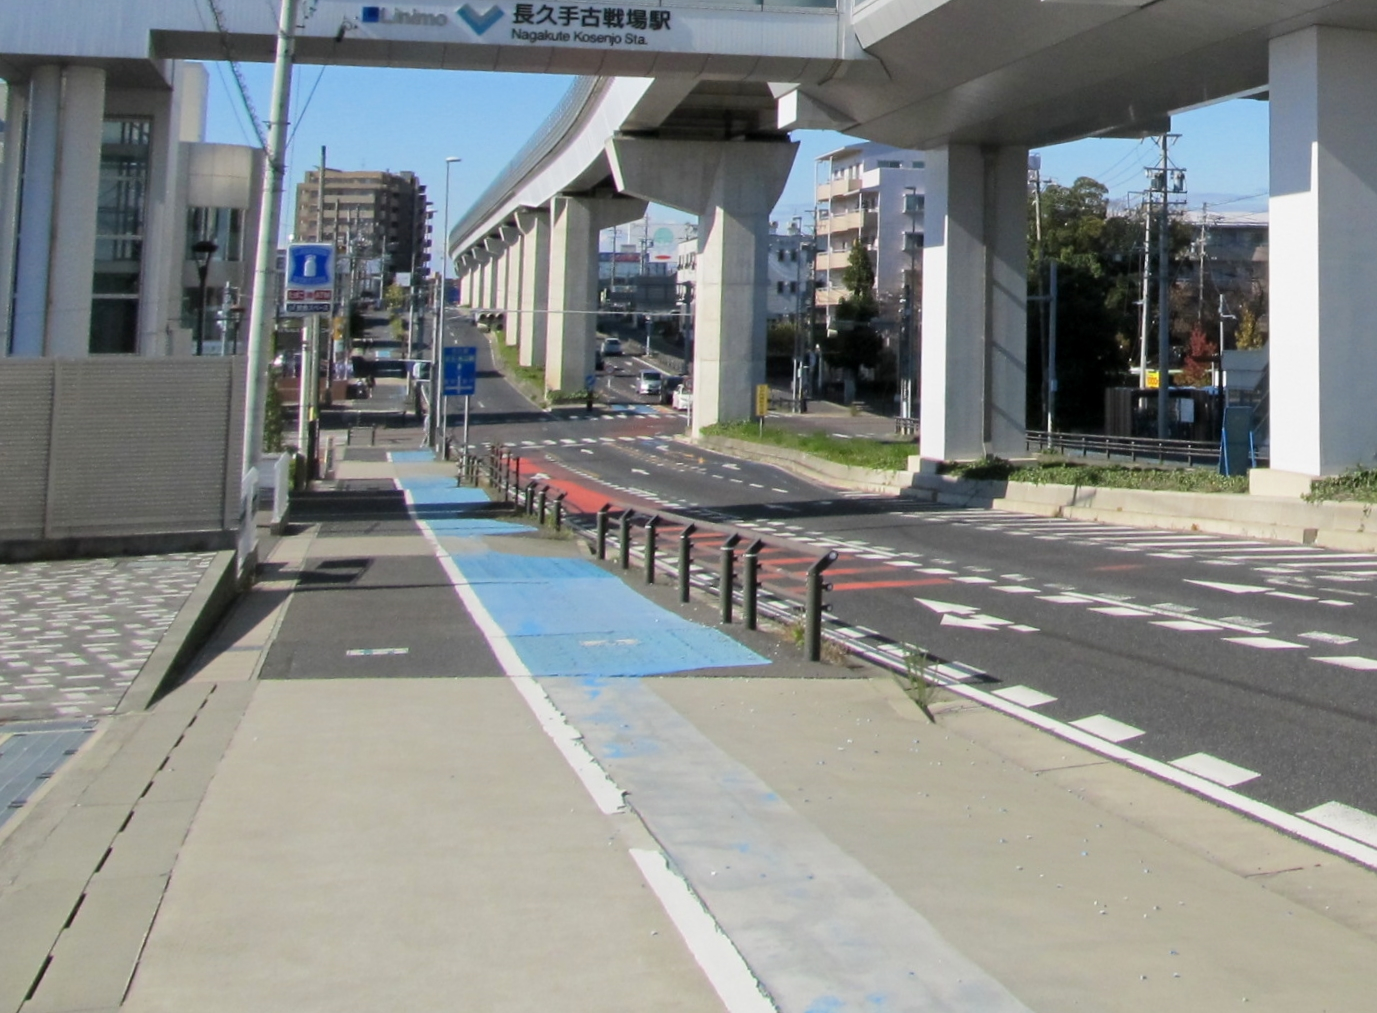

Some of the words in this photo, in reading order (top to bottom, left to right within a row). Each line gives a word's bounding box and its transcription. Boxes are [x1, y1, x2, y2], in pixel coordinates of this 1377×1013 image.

[381, 7, 448, 27] Linimo
[513, 4, 671, 30] 長久手古戦場駅
[511, 28, 570, 43] Nagakute
[574, 31, 622, 46] Kosenjo
[625, 33, 648, 45] Sta.
